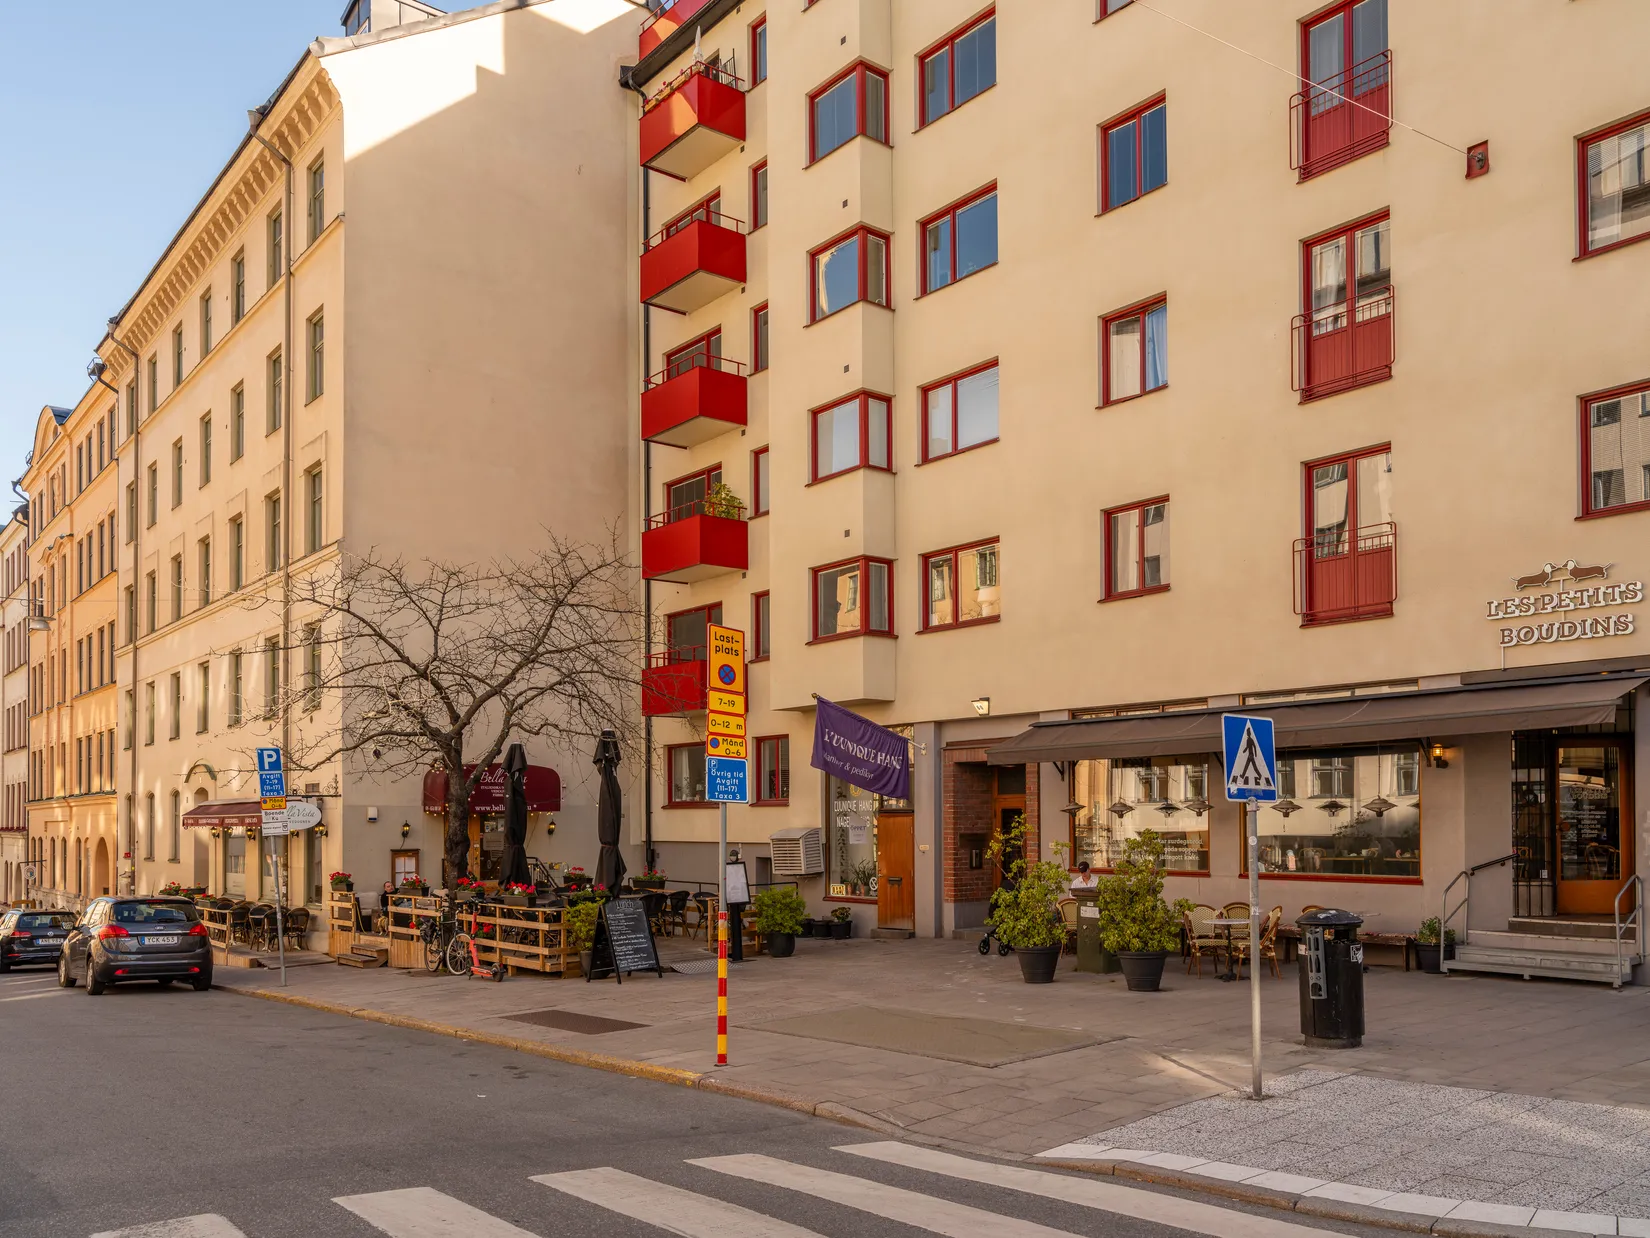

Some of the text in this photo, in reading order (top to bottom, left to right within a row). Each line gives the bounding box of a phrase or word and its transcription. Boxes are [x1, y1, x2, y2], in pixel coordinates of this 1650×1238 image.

[1486, 581, 1643, 620] LES PETITS
[1499, 613, 1635, 647] BOUDINS
[714, 631, 740, 644] Last-
[714, 644, 740, 657] plats
[717, 698, 736, 708] 7-19
[710, 719, 731, 729] 0-12
[721, 737, 744, 747] Månd
[823, 728, 877, 764] L'UUNIQUE
[724, 748, 742, 756] 0-6
[262, 750, 277, 770] P
[711, 760, 717, 768] P
[844, 762, 851, 771] &
[480, 767, 505, 783] Bella
[710, 768, 732, 778] Övrig
[715, 777, 739, 786] Avgift
[716, 784, 738, 792] (11-17)
[714, 792, 733, 800] Taxa
[858, 799, 873, 811] HANG
[295, 807, 316, 818] Vista
